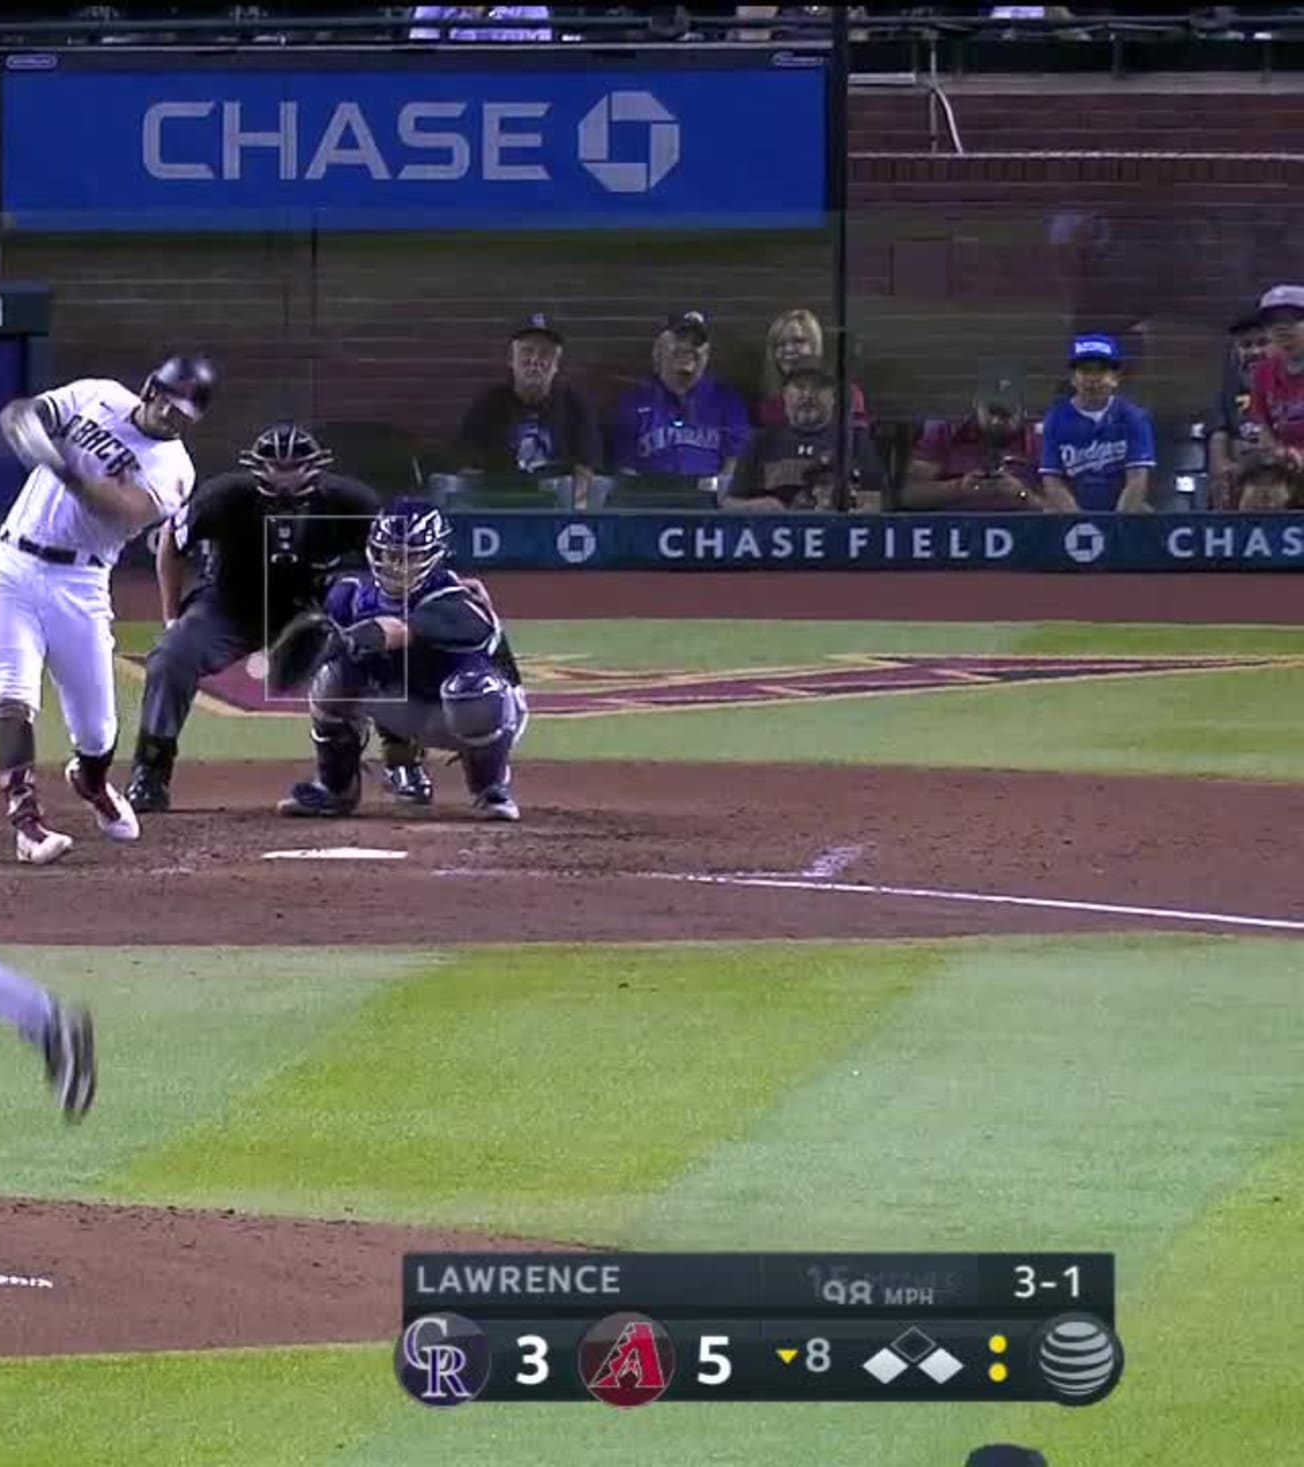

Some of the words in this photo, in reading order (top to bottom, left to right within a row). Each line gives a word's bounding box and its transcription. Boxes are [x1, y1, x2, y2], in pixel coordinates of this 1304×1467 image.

[142, 101, 551, 181] CHASE
[658, 527, 825, 559] CHASE
[849, 527, 1014, 559] FIELD
